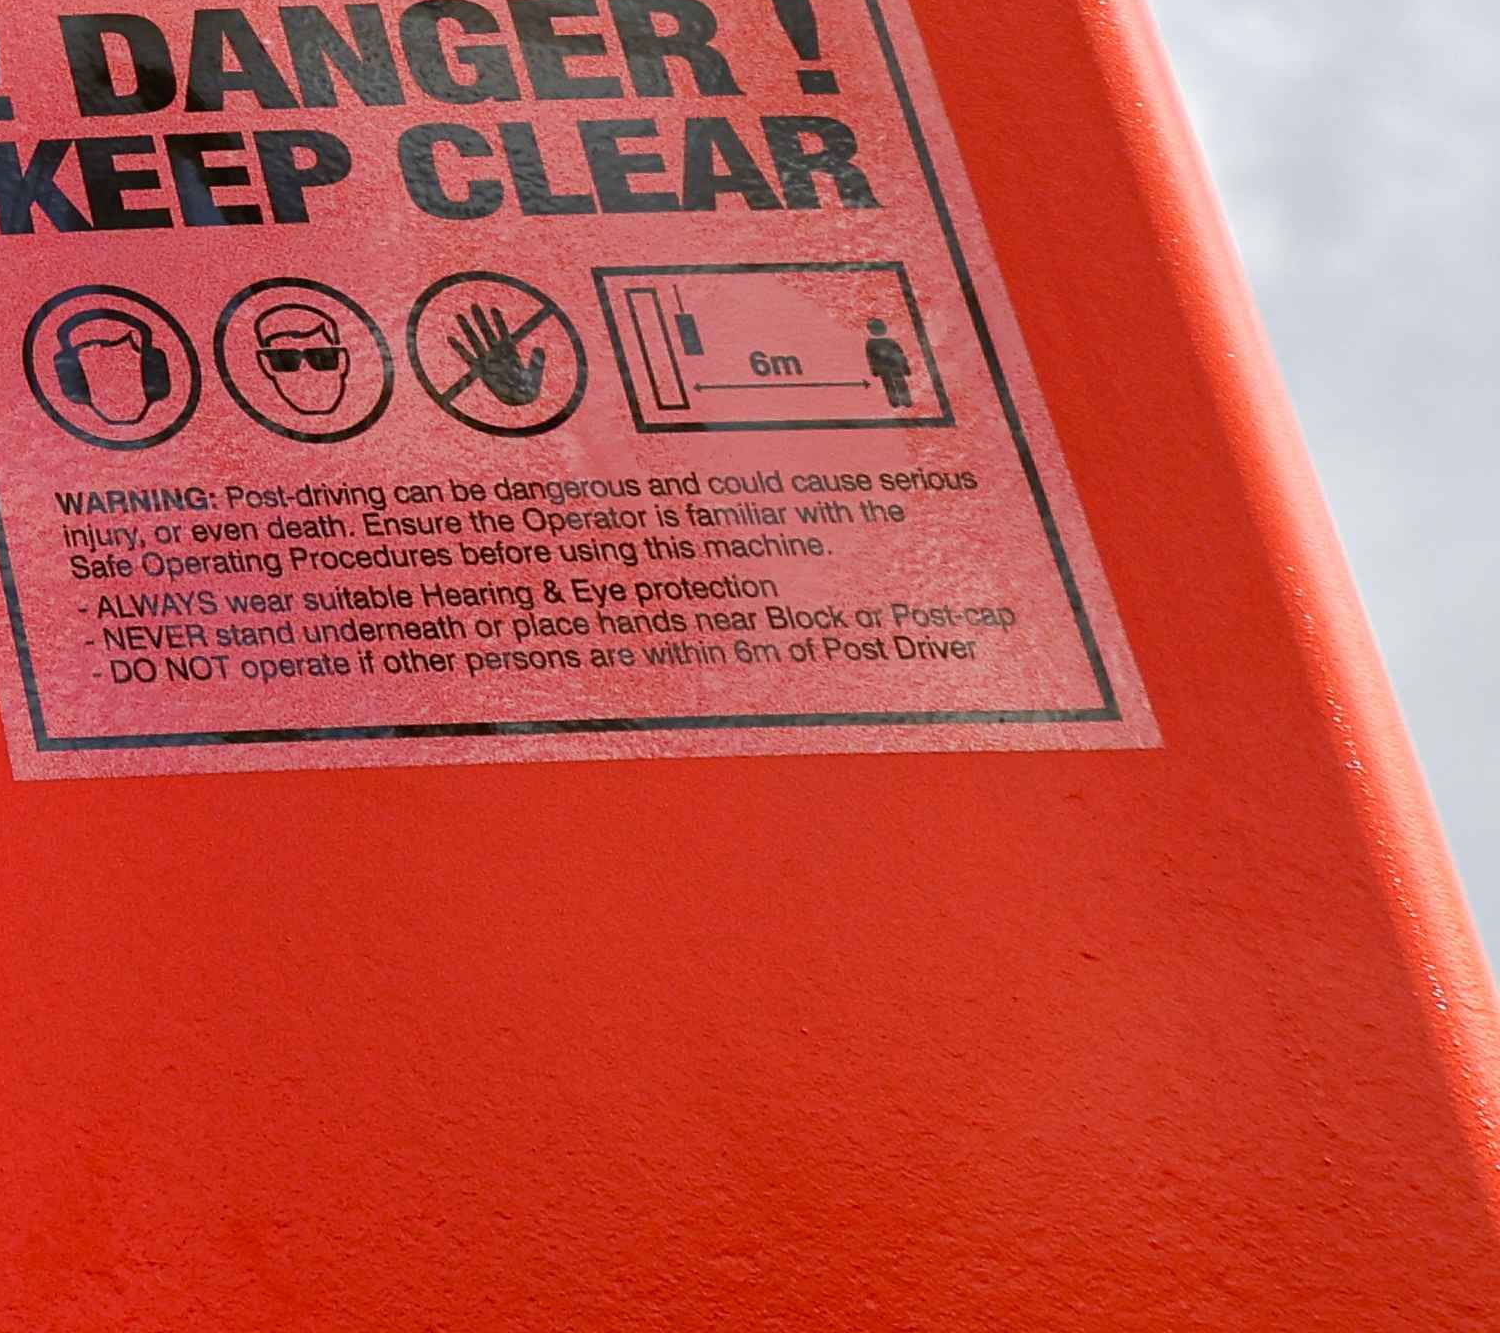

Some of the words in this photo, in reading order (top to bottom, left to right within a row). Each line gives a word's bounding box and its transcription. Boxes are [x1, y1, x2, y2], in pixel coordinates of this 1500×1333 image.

[396, 115, 884, 221] CLEAR
[747, 347, 804, 378] 6m
[53, 486, 219, 517] WARNING:
[224, 481, 388, 511] Post-driving
[392, 483, 445, 506] can
[492, 476, 642, 504] dangerous
[646, 470, 702, 499] and
[707, 469, 785, 496] could
[790, 472, 873, 494] cause
[878, 466, 979, 494] serious
[61, 521, 147, 552] injury,
[190, 521, 260, 545] even
[265, 514, 356, 541] death.
[361, 513, 464, 538] Ensure
[467, 510, 516, 535] the
[521, 506, 648, 539] Operator
[684, 502, 787, 528] familiar
[794, 500, 855, 525] with
[859, 499, 907, 523] the
[69, 553, 134, 583] Safe
[140, 547, 284, 581] Operating
[288, 547, 454, 572] Procedures
[462, 541, 553, 566] before
[556, 537, 639, 568] using
[642, 535, 701, 561] this
[702, 532, 833, 560] machine.
[96, 590, 219, 620] ALWAYS
[224, 592, 294, 615] wear
[302, 585, 415, 613] suitable
[419, 582, 536, 613] Hearing
[569, 579, 628, 610] Eye
[633, 575, 779, 609] protection
[101, 624, 209, 652] NEVER
[215, 622, 296, 649] stand
[301, 617, 468, 653] underneath
[511, 614, 591, 645] place
[594, 610, 689, 644] hands
[694, 610, 758, 634] near
[764, 605, 850, 631] Block
[889, 603, 1017, 633] Post-cap
[164, 654, 230, 683] NOT
[240, 651, 352, 686] operate
[382, 648, 457, 676] other
[464, 646, 583, 679] persons
[589, 647, 637, 671] are
[640, 639, 728, 668] within
[821, 635, 890, 662] Post
[891, 631, 979, 662] Driver
